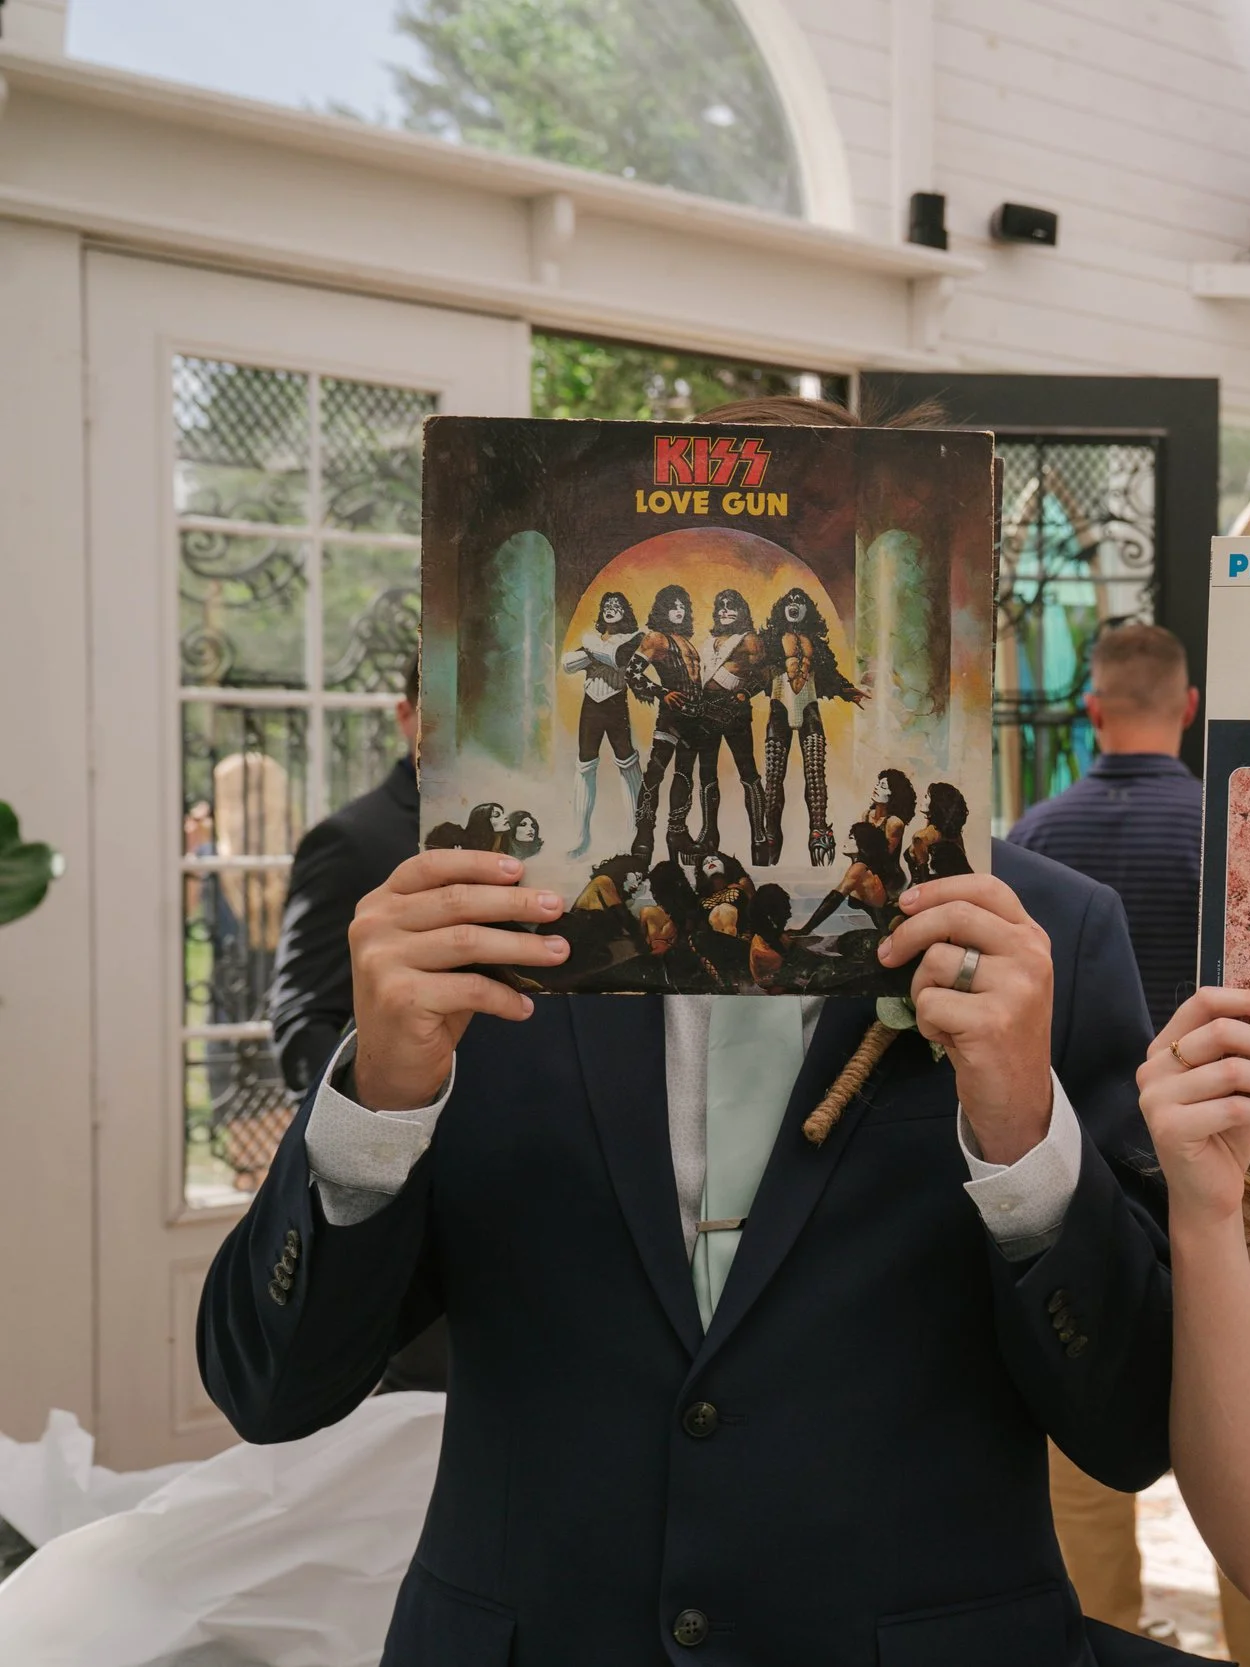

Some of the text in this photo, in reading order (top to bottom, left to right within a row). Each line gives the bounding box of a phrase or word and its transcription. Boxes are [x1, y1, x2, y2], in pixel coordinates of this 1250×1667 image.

[654, 435, 771, 488] KISS
[635, 490, 788, 516] LOVE GUN
